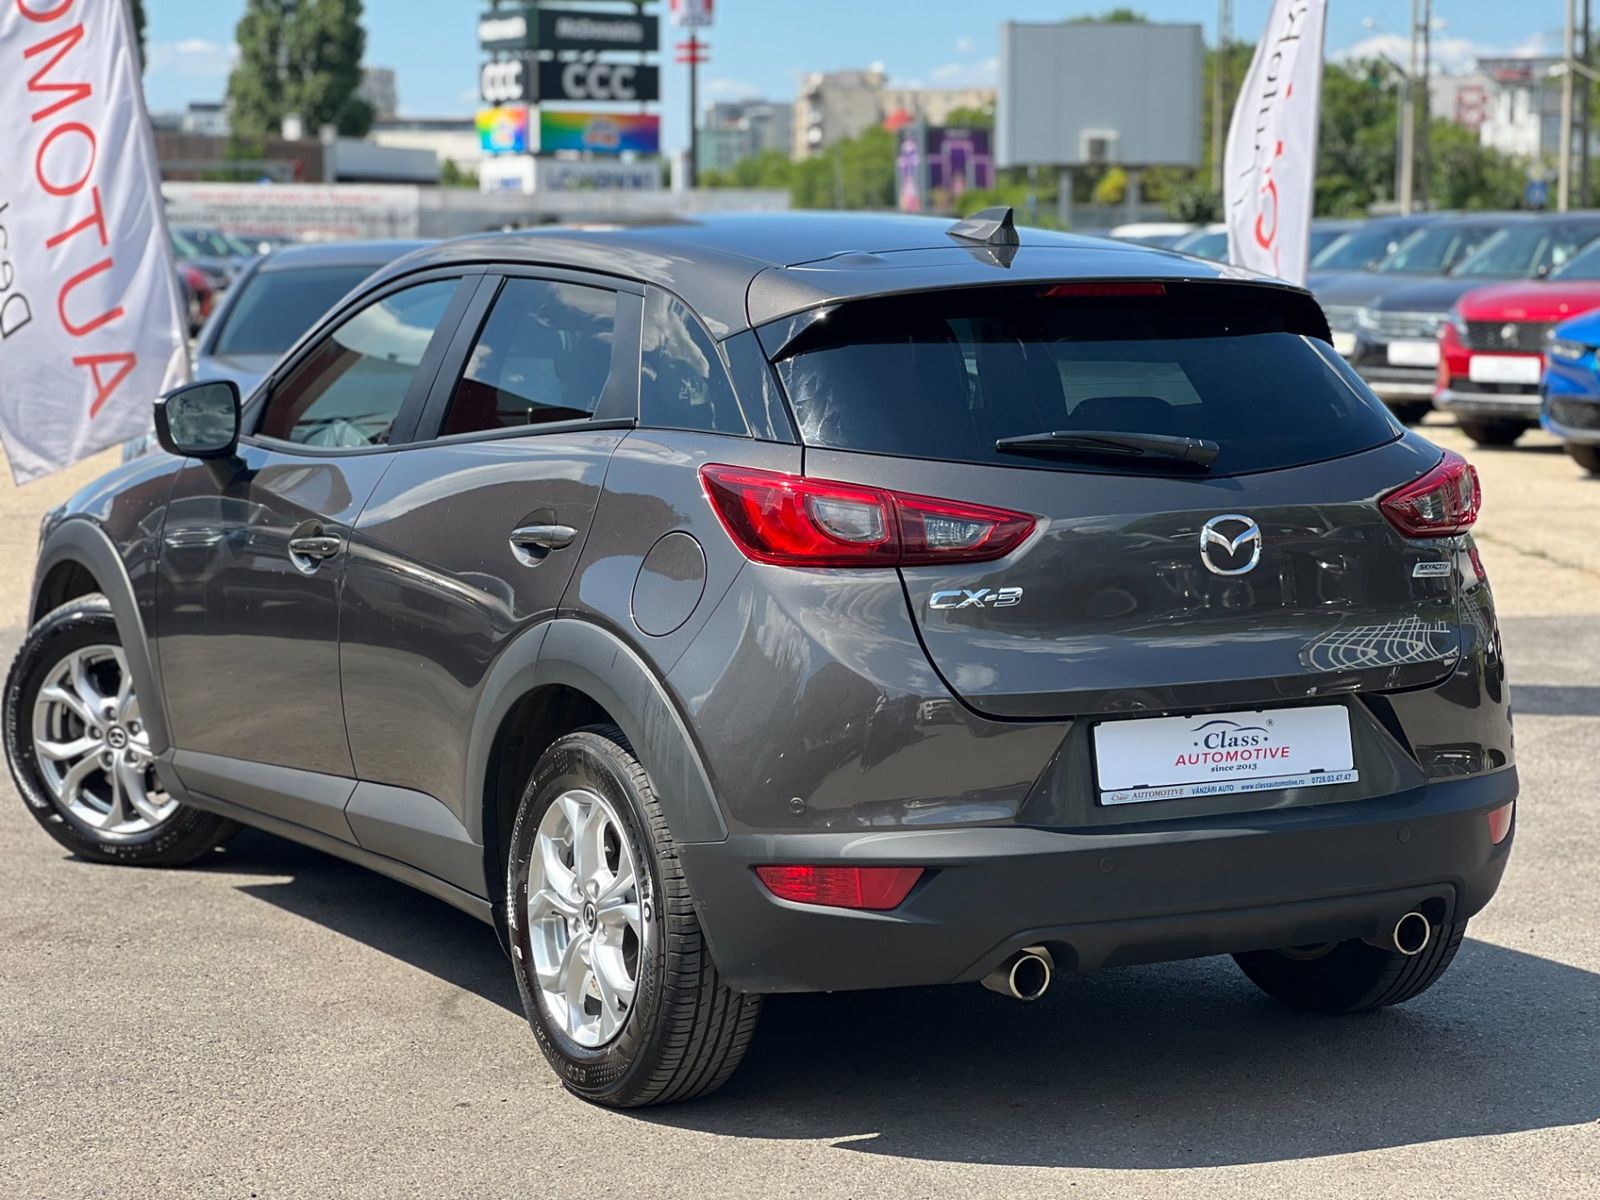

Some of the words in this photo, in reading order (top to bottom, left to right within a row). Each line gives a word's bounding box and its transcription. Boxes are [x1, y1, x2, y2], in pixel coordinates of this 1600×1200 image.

[561, 62, 637, 100] CCC
[929, 587, 1023, 609] CX-3
[1203, 731, 1259, 750] Class
[1175, 746, 1290, 766] AUTOMOTIVE
[1211, 764, 1234, 773] since
[1236, 763, 1258, 771] 2013
[1131, 788, 1185, 799] AUTOMOTIVE
[1218, 784, 1235, 793] AUTO
[1241, 779, 1305, 790] www.classautomotive.ro
